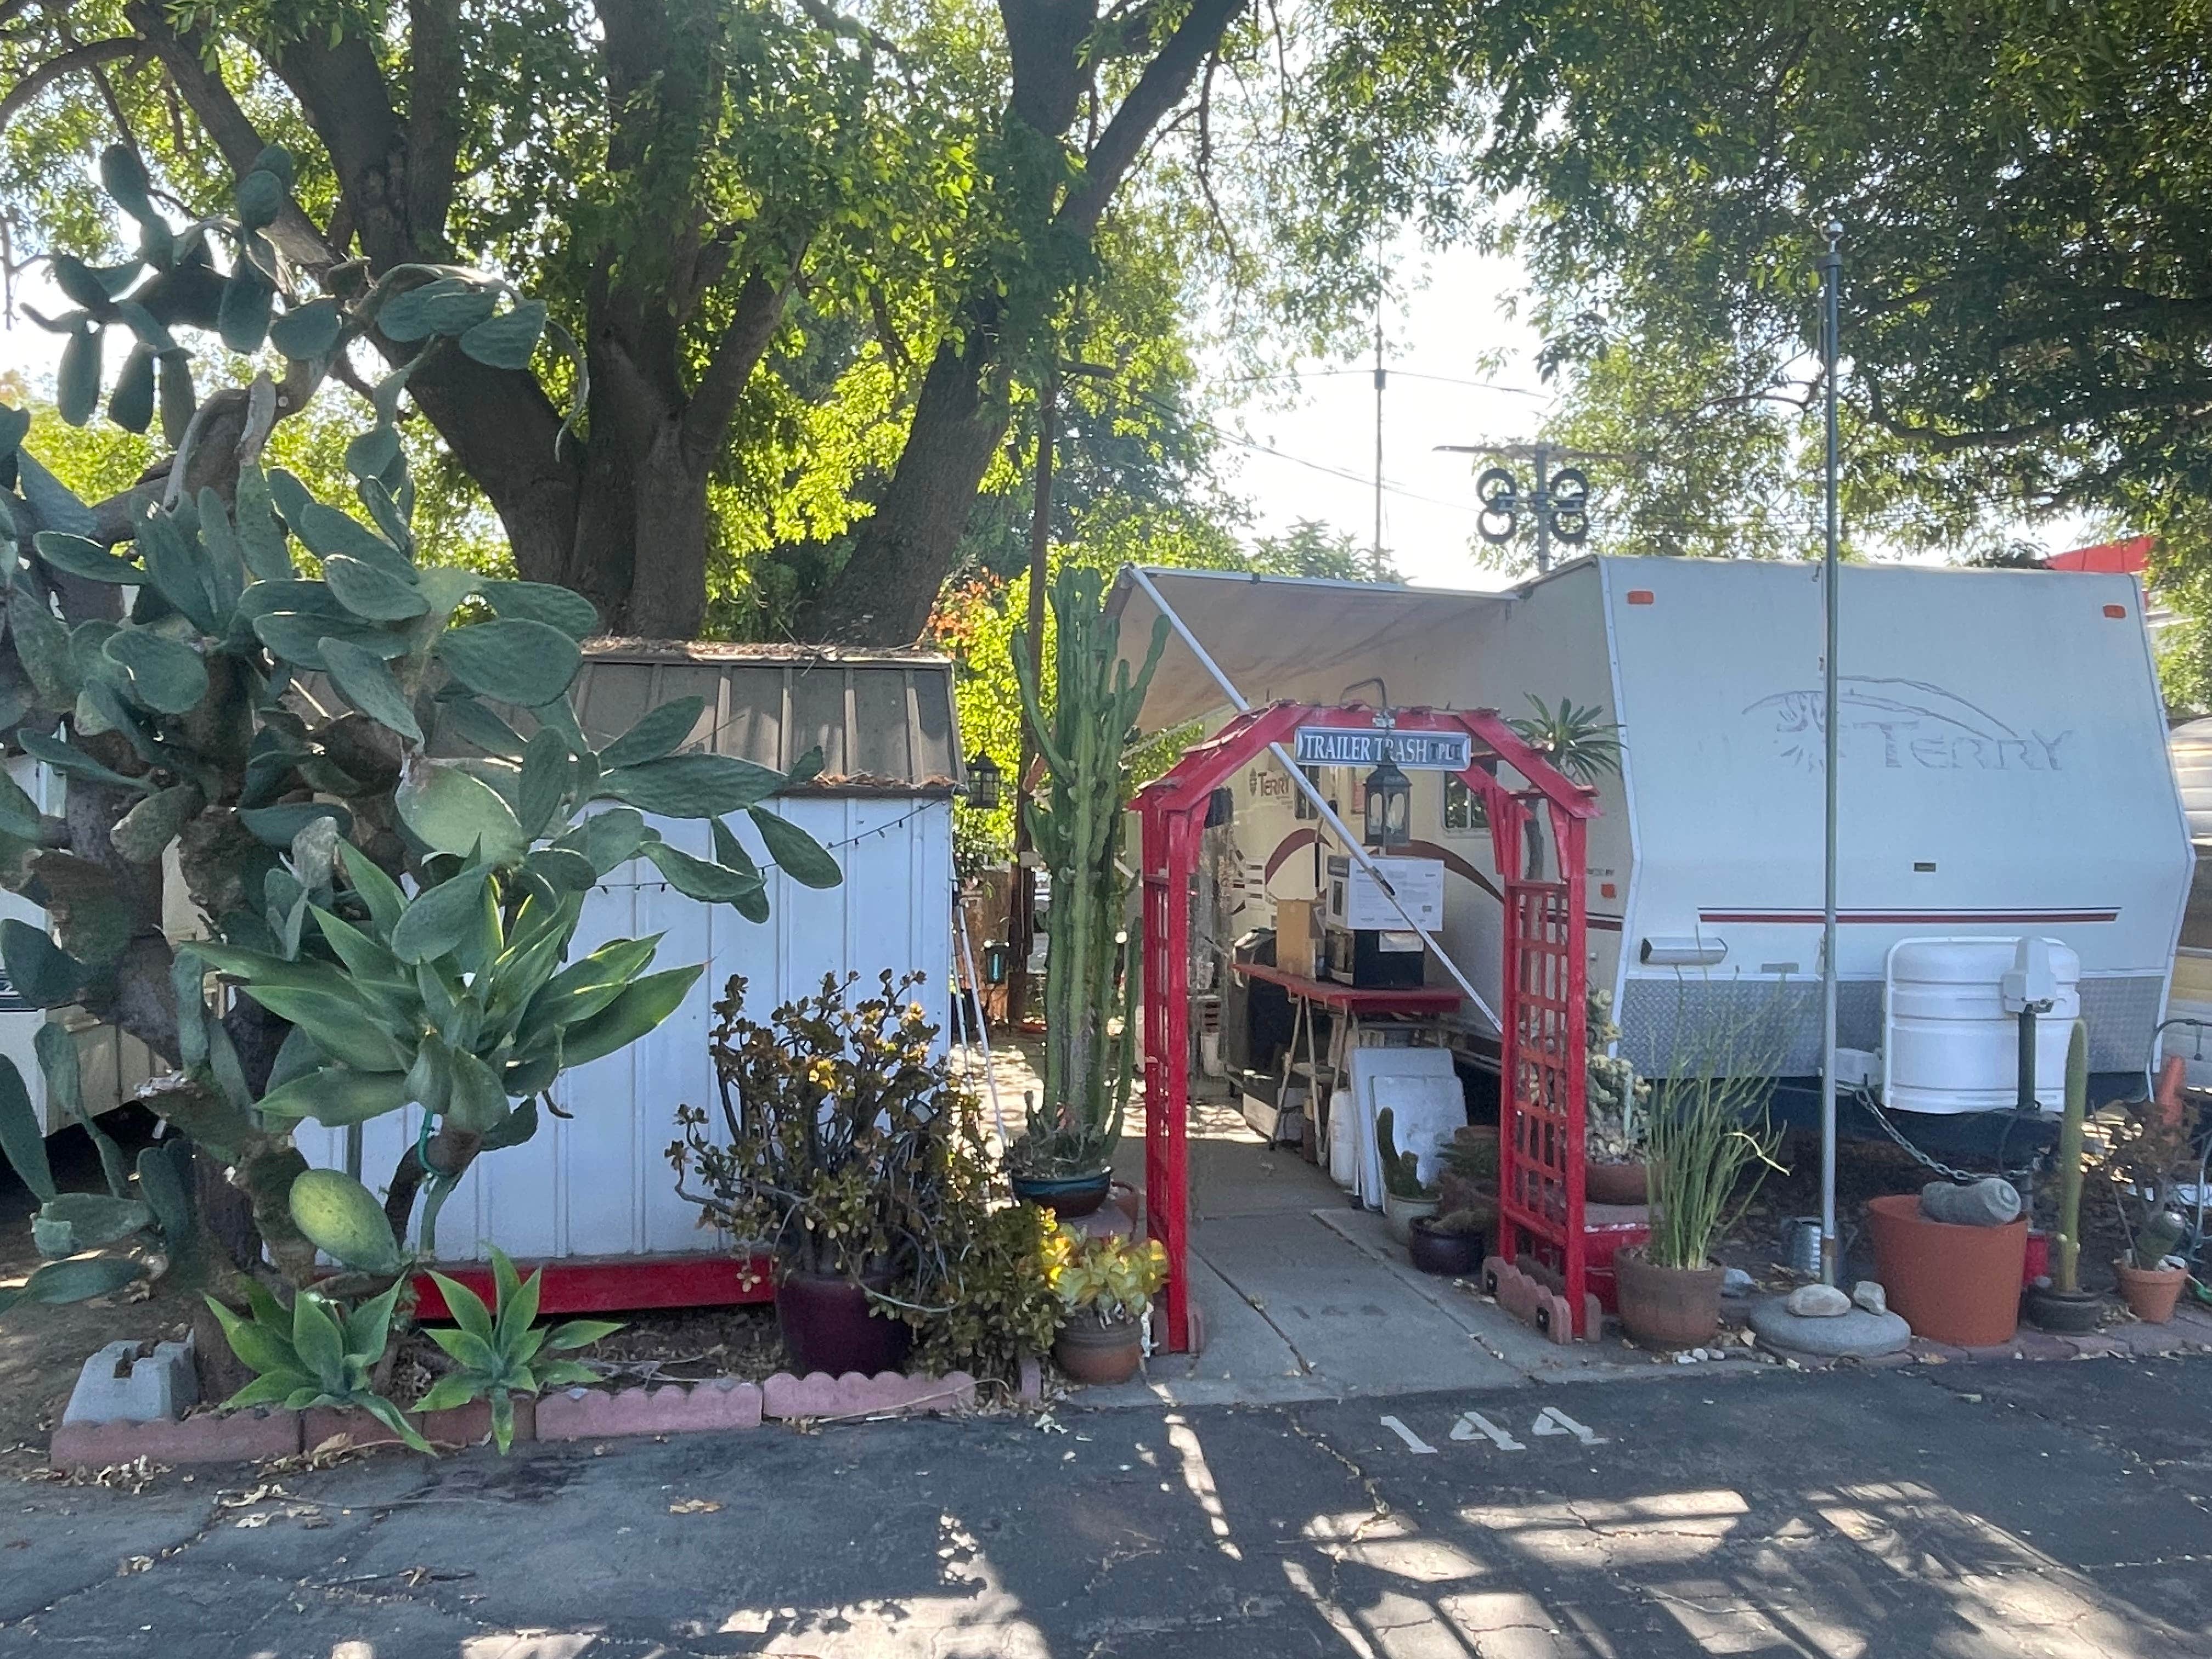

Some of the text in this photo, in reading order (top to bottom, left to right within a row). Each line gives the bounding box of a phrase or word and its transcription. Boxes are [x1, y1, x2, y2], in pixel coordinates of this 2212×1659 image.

[1305, 734, 1370, 760] TRAILER
[1374, 737, 1427, 763] TRASH
[1379, 1406, 1610, 1454] 144
